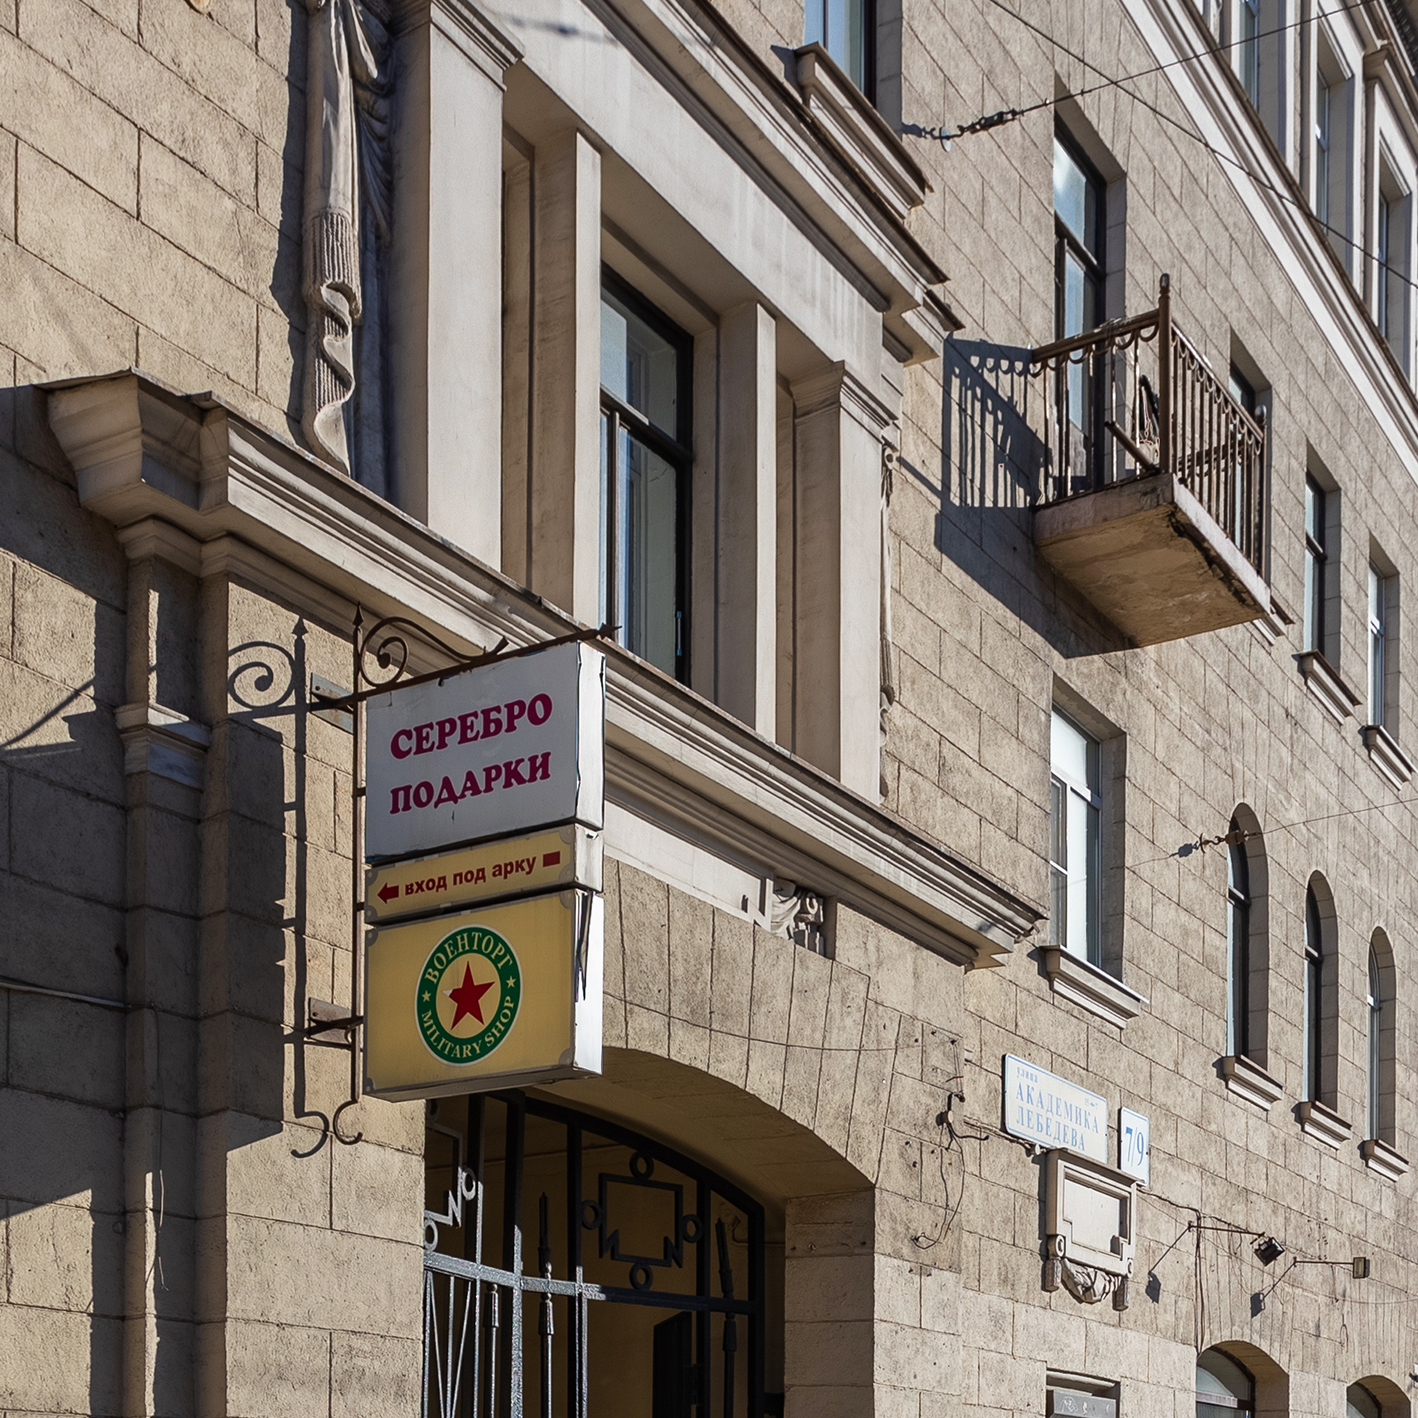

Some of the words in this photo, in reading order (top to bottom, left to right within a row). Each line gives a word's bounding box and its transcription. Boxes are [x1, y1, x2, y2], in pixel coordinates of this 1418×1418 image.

[389, 692, 554, 760] СЕРЕБРО
[389, 751, 552, 815] ПОДАРКИ
[404, 873, 448, 897] вход
[452, 866, 487, 889] под
[491, 856, 537, 882] арку
[424, 931, 514, 985] ВОЕНТОРГ
[421, 1009, 483, 1059] MILITARY
[484, 995, 515, 1047] SHOP
[1016, 1066, 1039, 1084] улица
[1015, 1081, 1100, 1135] АКАДЕМИКА
[1016, 1106, 1086, 1151] ЛЕБЕДЕВА
[1125, 1126, 1145, 1167] 7/9
